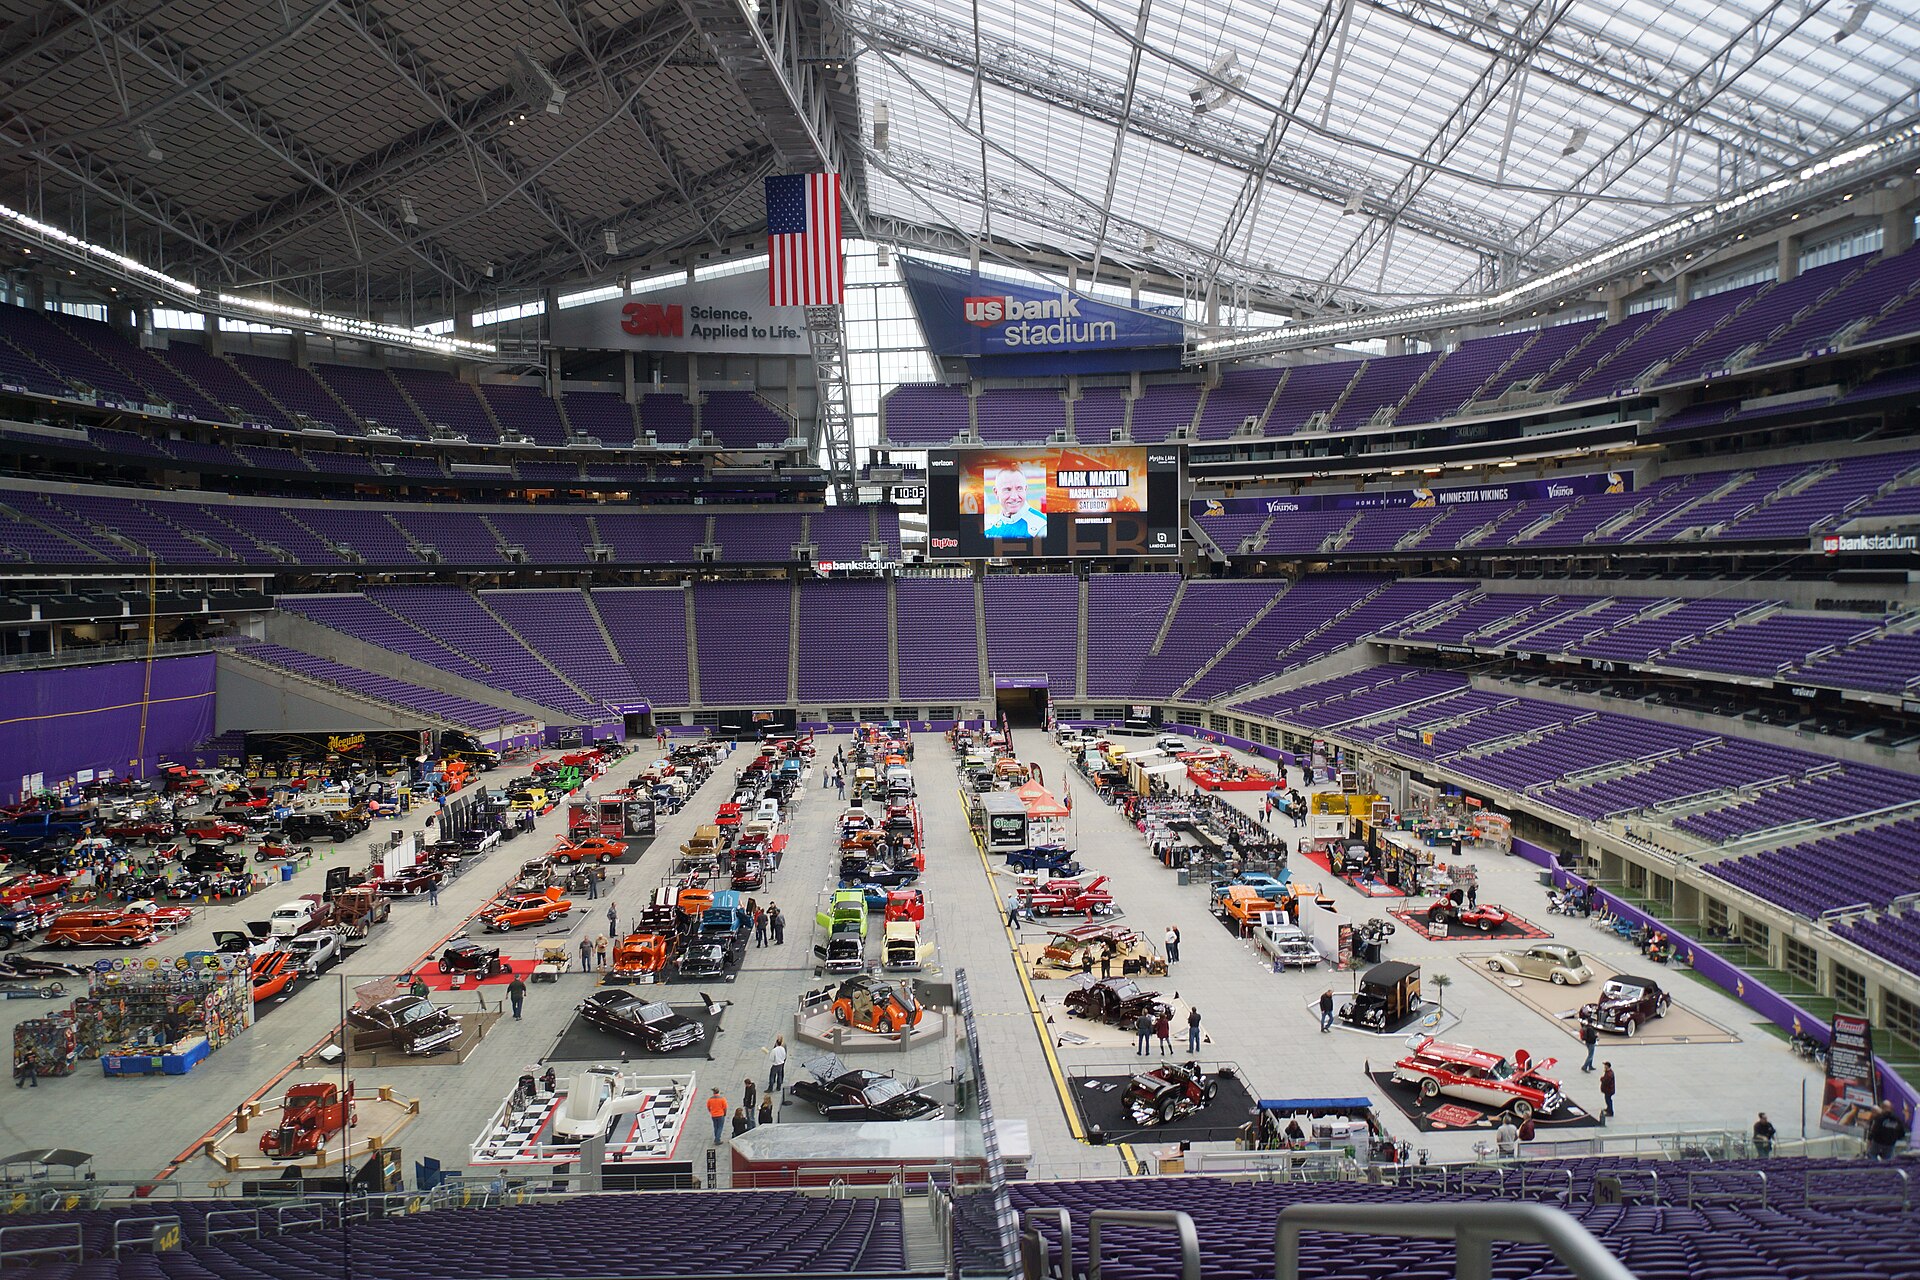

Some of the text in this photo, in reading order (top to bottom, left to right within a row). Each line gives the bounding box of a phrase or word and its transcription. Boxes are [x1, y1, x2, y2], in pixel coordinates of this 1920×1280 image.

[621, 303, 683, 337] 3M
[690, 305, 752, 321] Science.
[690, 322, 801, 341] Applied to Life.
[1004, 318, 1116, 346] stadium
[1058, 470, 1127, 486] MARK MARTIN
[900, 487, 926, 498] 10:03
[1069, 488, 1118, 499] NASCAR LEGEND
[1439, 488, 1509, 504] MINNESOTA VIKINGS
[1079, 501, 1108, 510] SATURDAY
[328, 733, 366, 752] Meguiar's
[159, 1226, 180, 1251] 142
